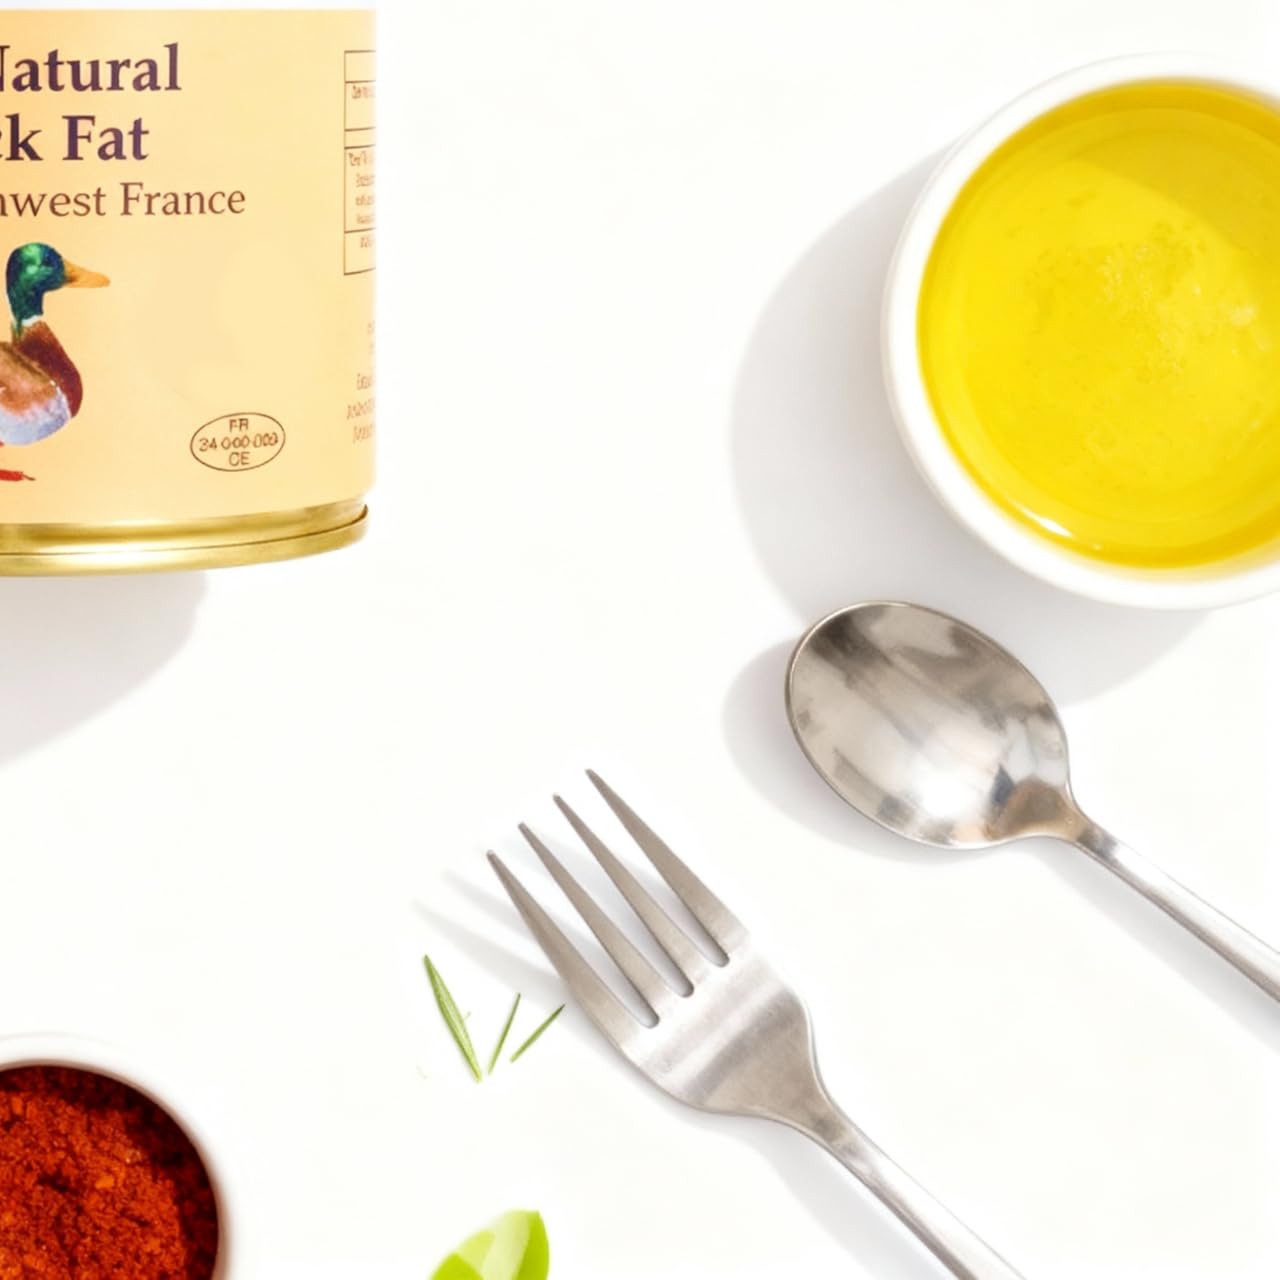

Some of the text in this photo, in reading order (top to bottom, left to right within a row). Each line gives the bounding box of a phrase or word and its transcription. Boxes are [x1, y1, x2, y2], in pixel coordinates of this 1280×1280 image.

[61, 115, 151, 162] Fat
[120, 182, 246, 217] France
[229, 418, 249, 432] FR
[228, 451, 251, 467] CE
